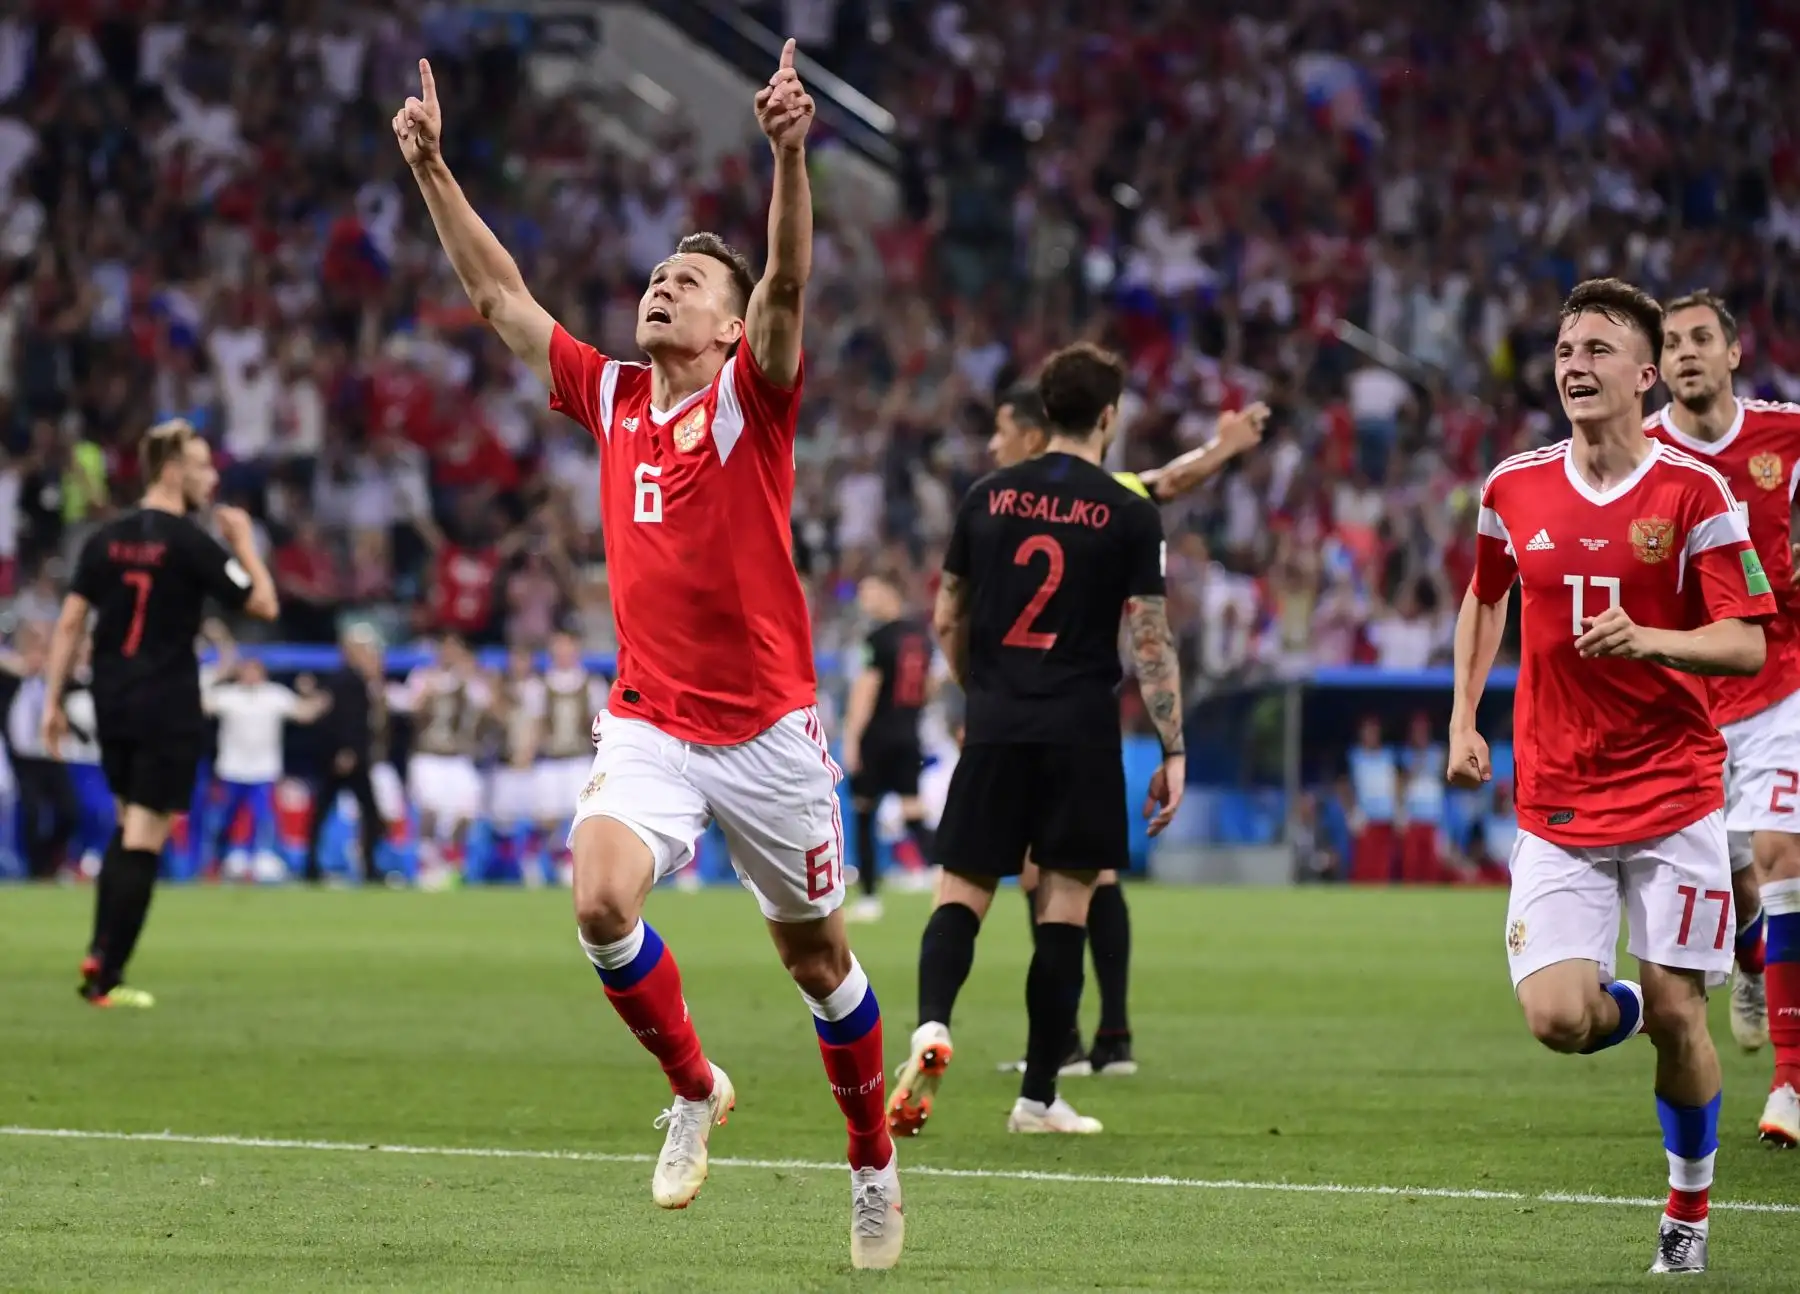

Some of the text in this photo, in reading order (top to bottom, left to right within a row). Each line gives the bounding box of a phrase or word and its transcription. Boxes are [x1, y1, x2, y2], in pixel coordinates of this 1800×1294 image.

[633, 462, 663, 523] 6
[988, 488, 1111, 529] VRSALJKO
[1526, 542, 1555, 551] adidas
[121, 571, 153, 659] 7
[1002, 534, 1065, 650] 2
[1563, 574, 1621, 636] 17
[1770, 768, 1799, 813] 2
[805, 840, 835, 901] 6
[1677, 884, 1731, 950] 17
